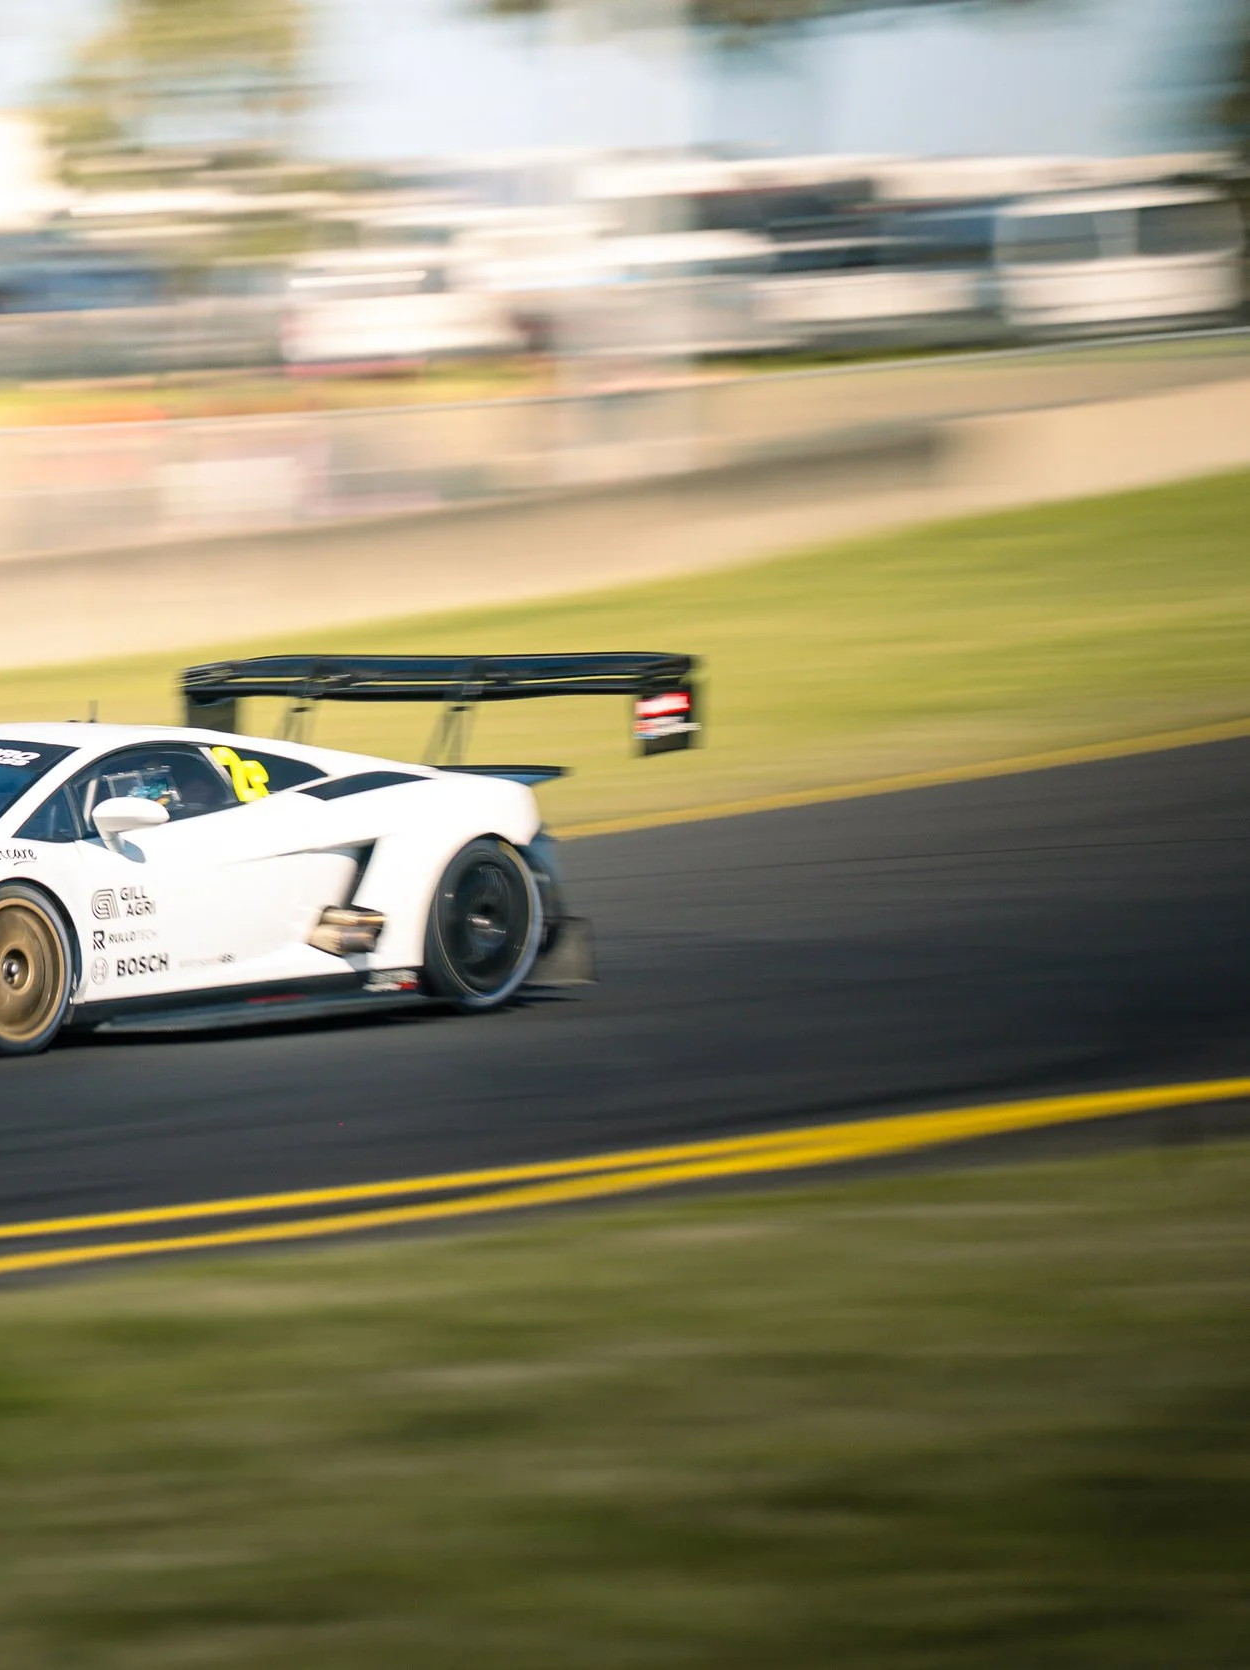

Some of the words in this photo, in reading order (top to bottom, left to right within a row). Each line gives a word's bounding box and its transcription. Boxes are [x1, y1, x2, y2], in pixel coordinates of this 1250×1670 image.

[119, 886, 149, 901] GILL
[126, 900, 157, 917] AGRI
[116, 952, 169, 977] BOSCH
